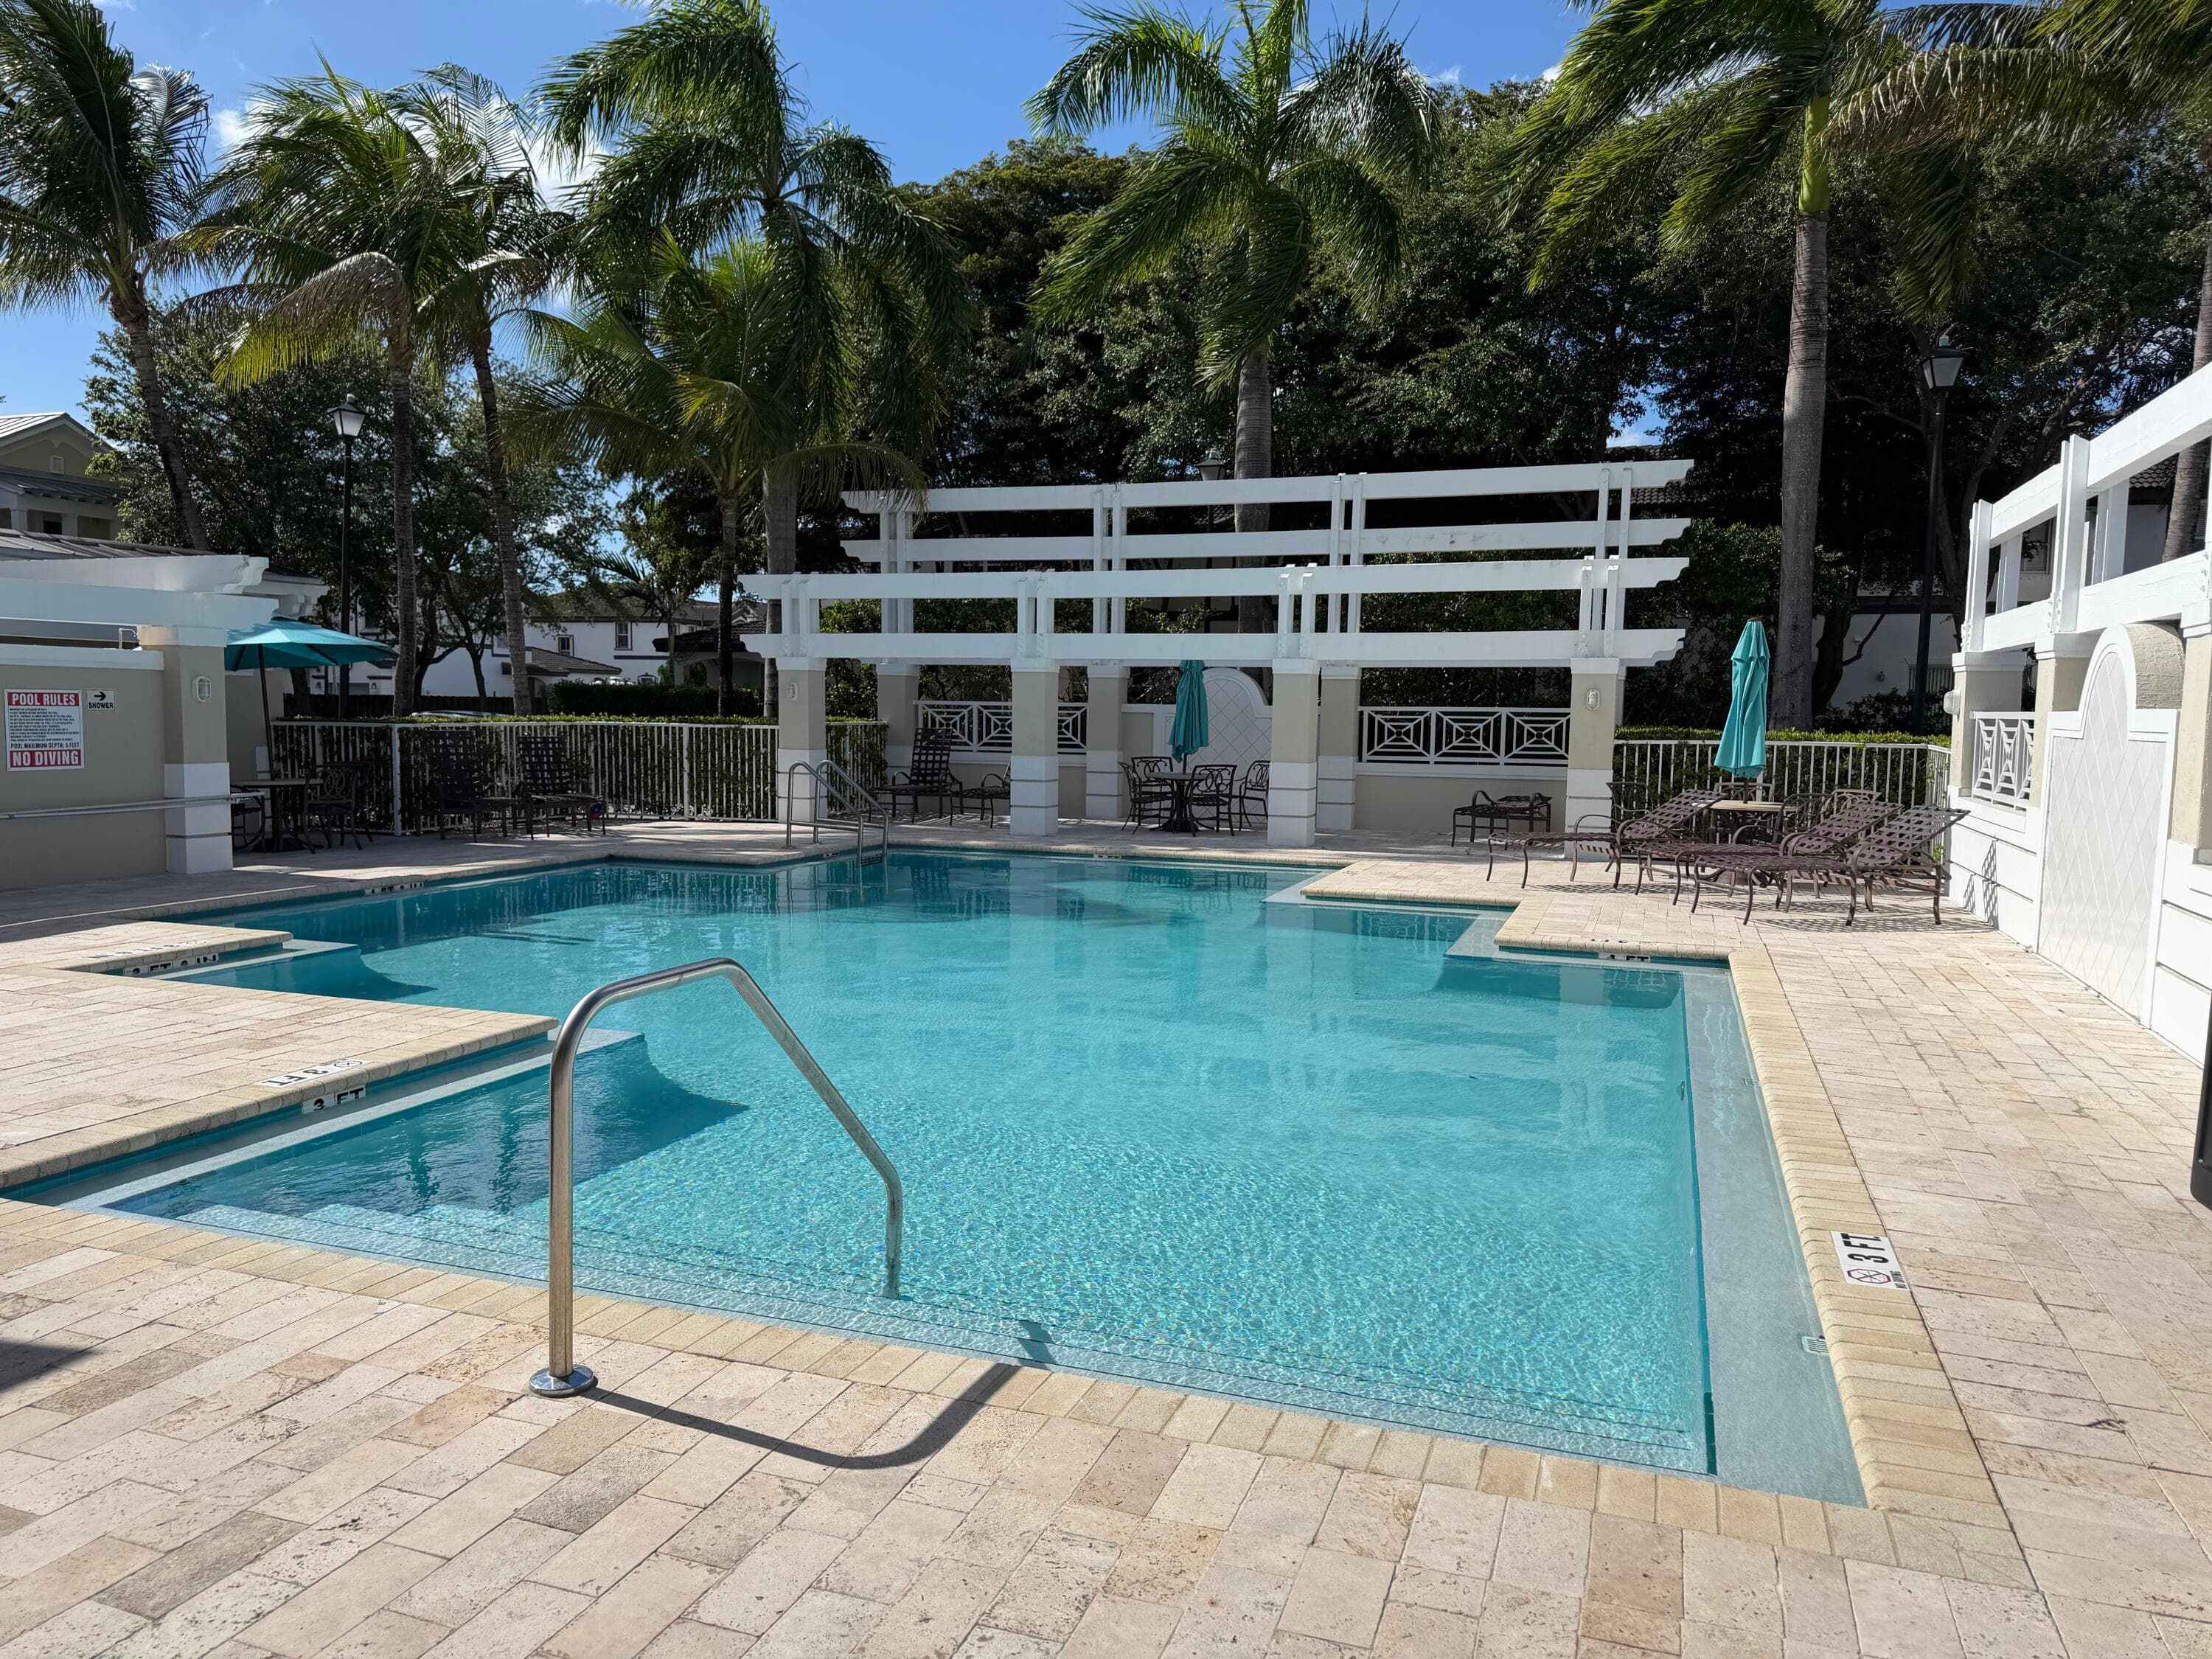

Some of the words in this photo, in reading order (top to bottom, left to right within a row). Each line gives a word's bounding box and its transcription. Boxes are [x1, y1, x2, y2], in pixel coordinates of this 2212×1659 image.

[12, 693, 41, 705] POOL
[43, 694, 75, 706] RULES
[13, 751, 31, 766] NO
[35, 750, 79, 766] DIVING
[336, 1087, 364, 1105] FT
[1847, 1253, 1889, 1264] 3
